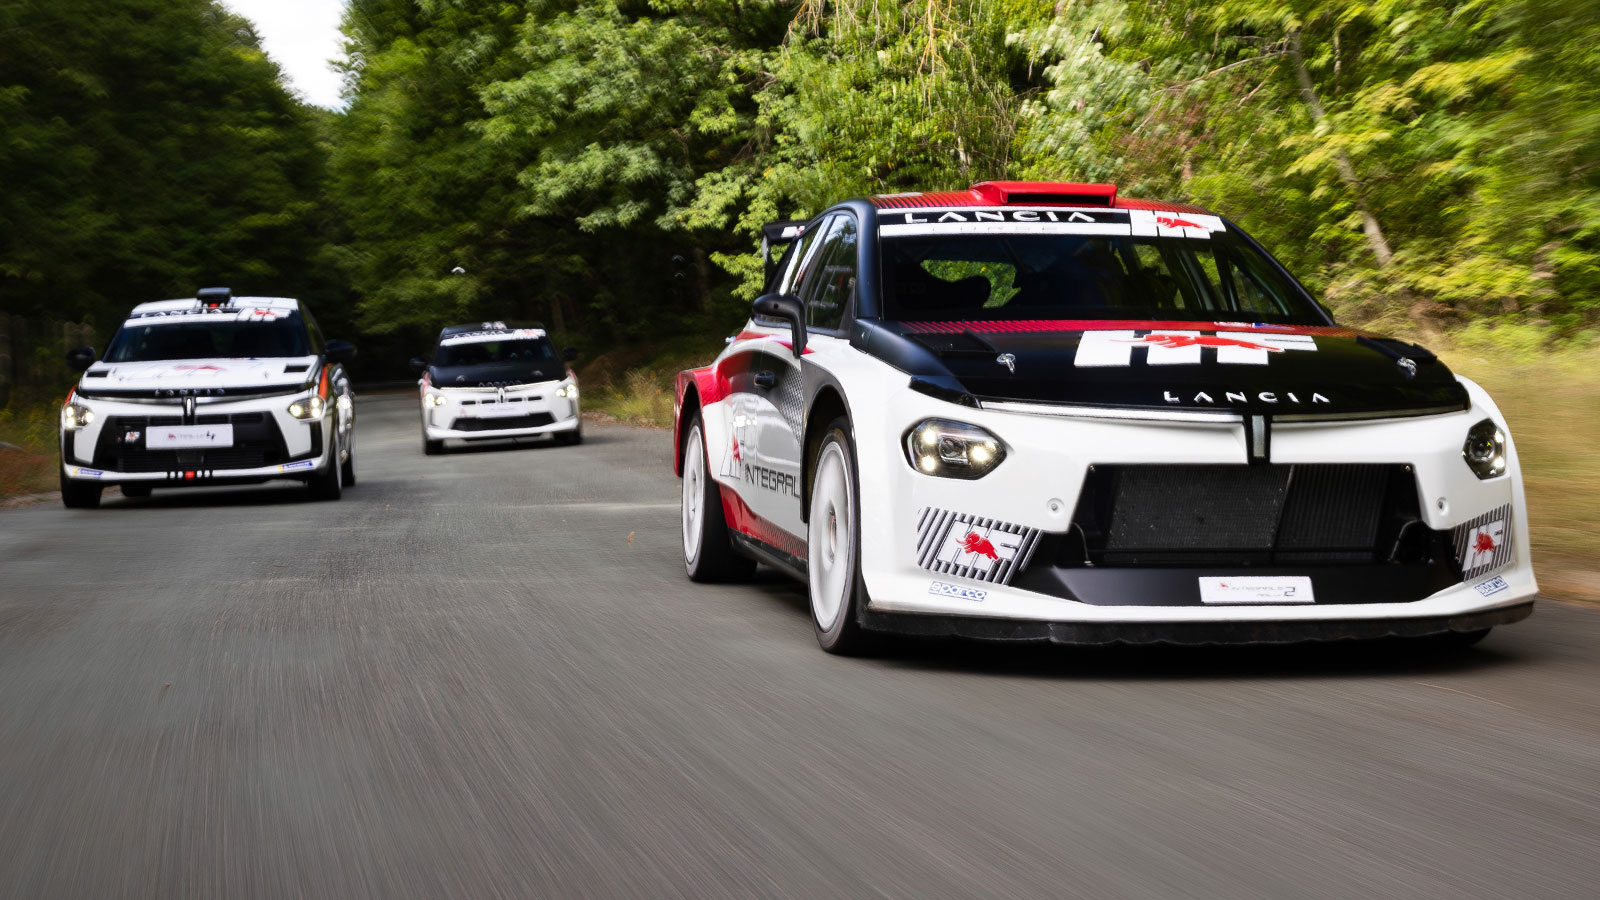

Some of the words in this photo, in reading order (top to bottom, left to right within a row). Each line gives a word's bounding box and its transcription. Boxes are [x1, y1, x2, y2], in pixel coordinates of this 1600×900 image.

[904, 210, 1096, 224] LANCIA
[1073, 329, 1318, 367] HF
[1163, 390, 1331, 404] LANCIA
